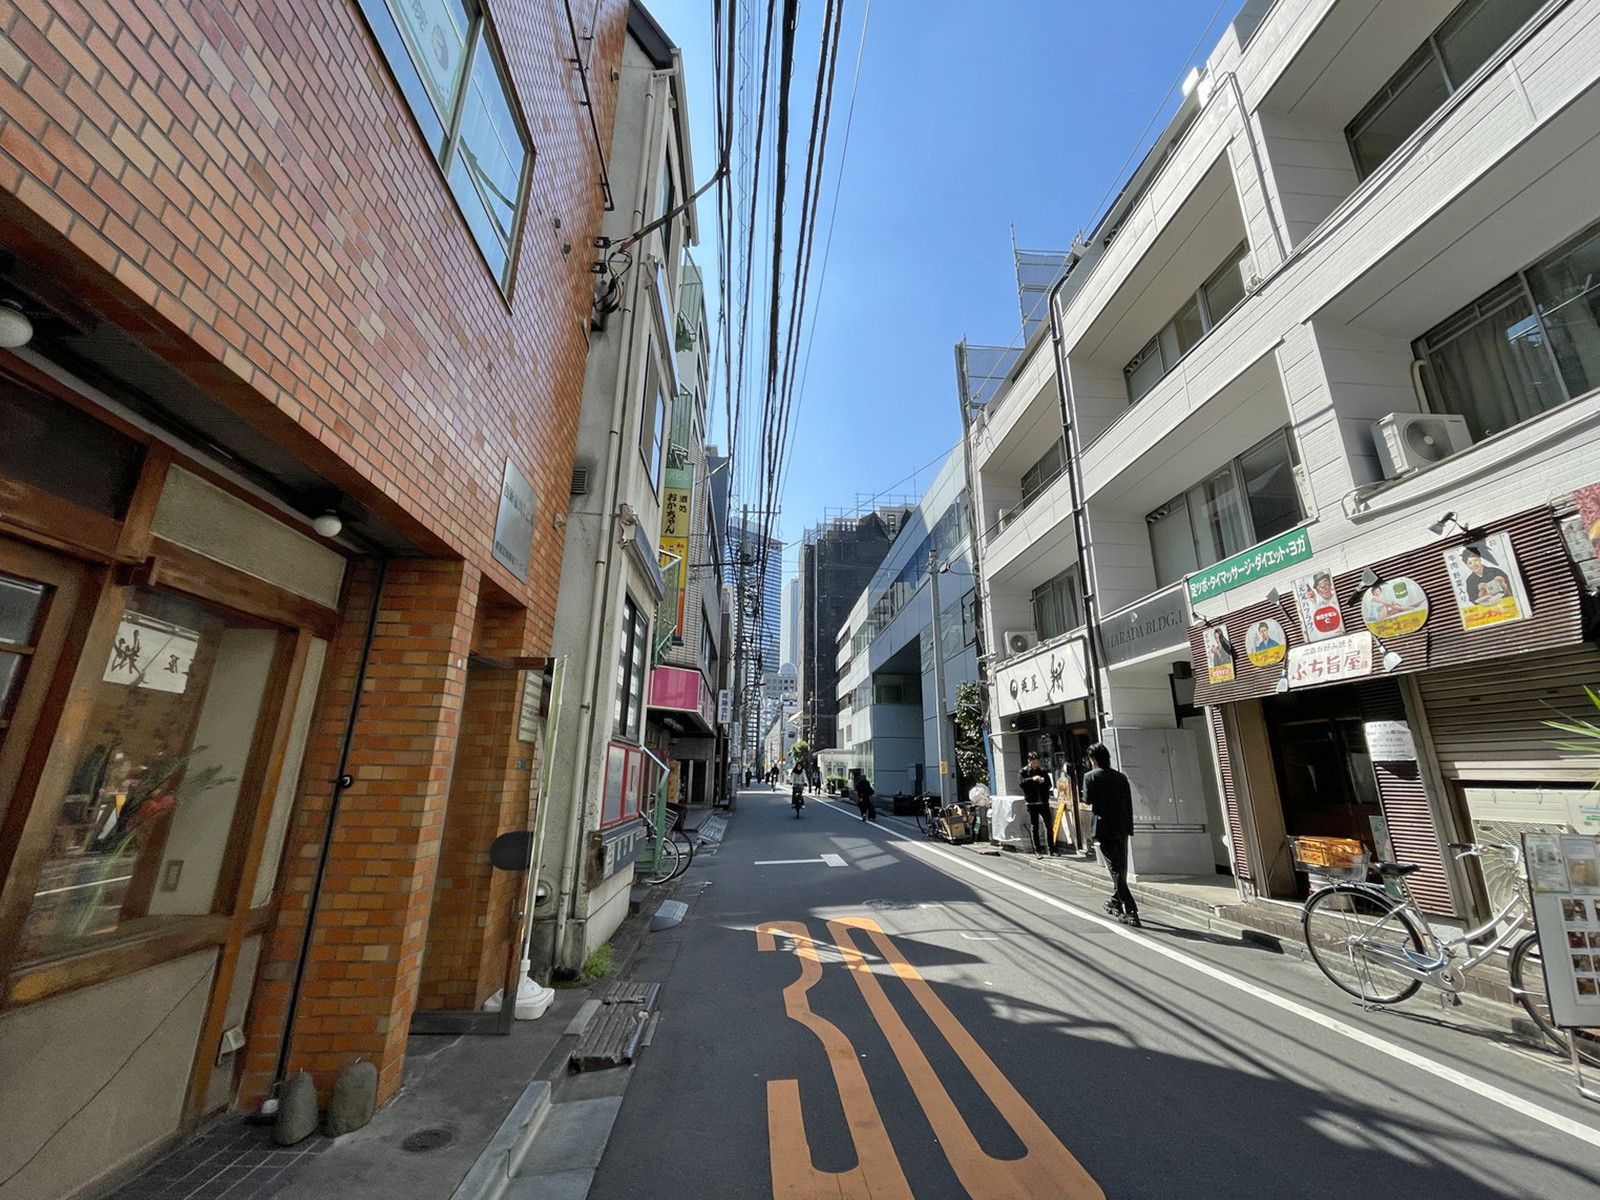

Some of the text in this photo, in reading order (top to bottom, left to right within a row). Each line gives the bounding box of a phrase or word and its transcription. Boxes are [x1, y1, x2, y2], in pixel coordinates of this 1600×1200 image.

[665, 493, 677, 534] おかちゃん
[1190, 535, 1306, 598] 足ツボ・タイマッサージ・ダイエット・ヨガ
[1106, 624, 1144, 649] HARADA
[1292, 650, 1360, 681] ぶち旨屋
[756, 917, 1107, 1200] 30
